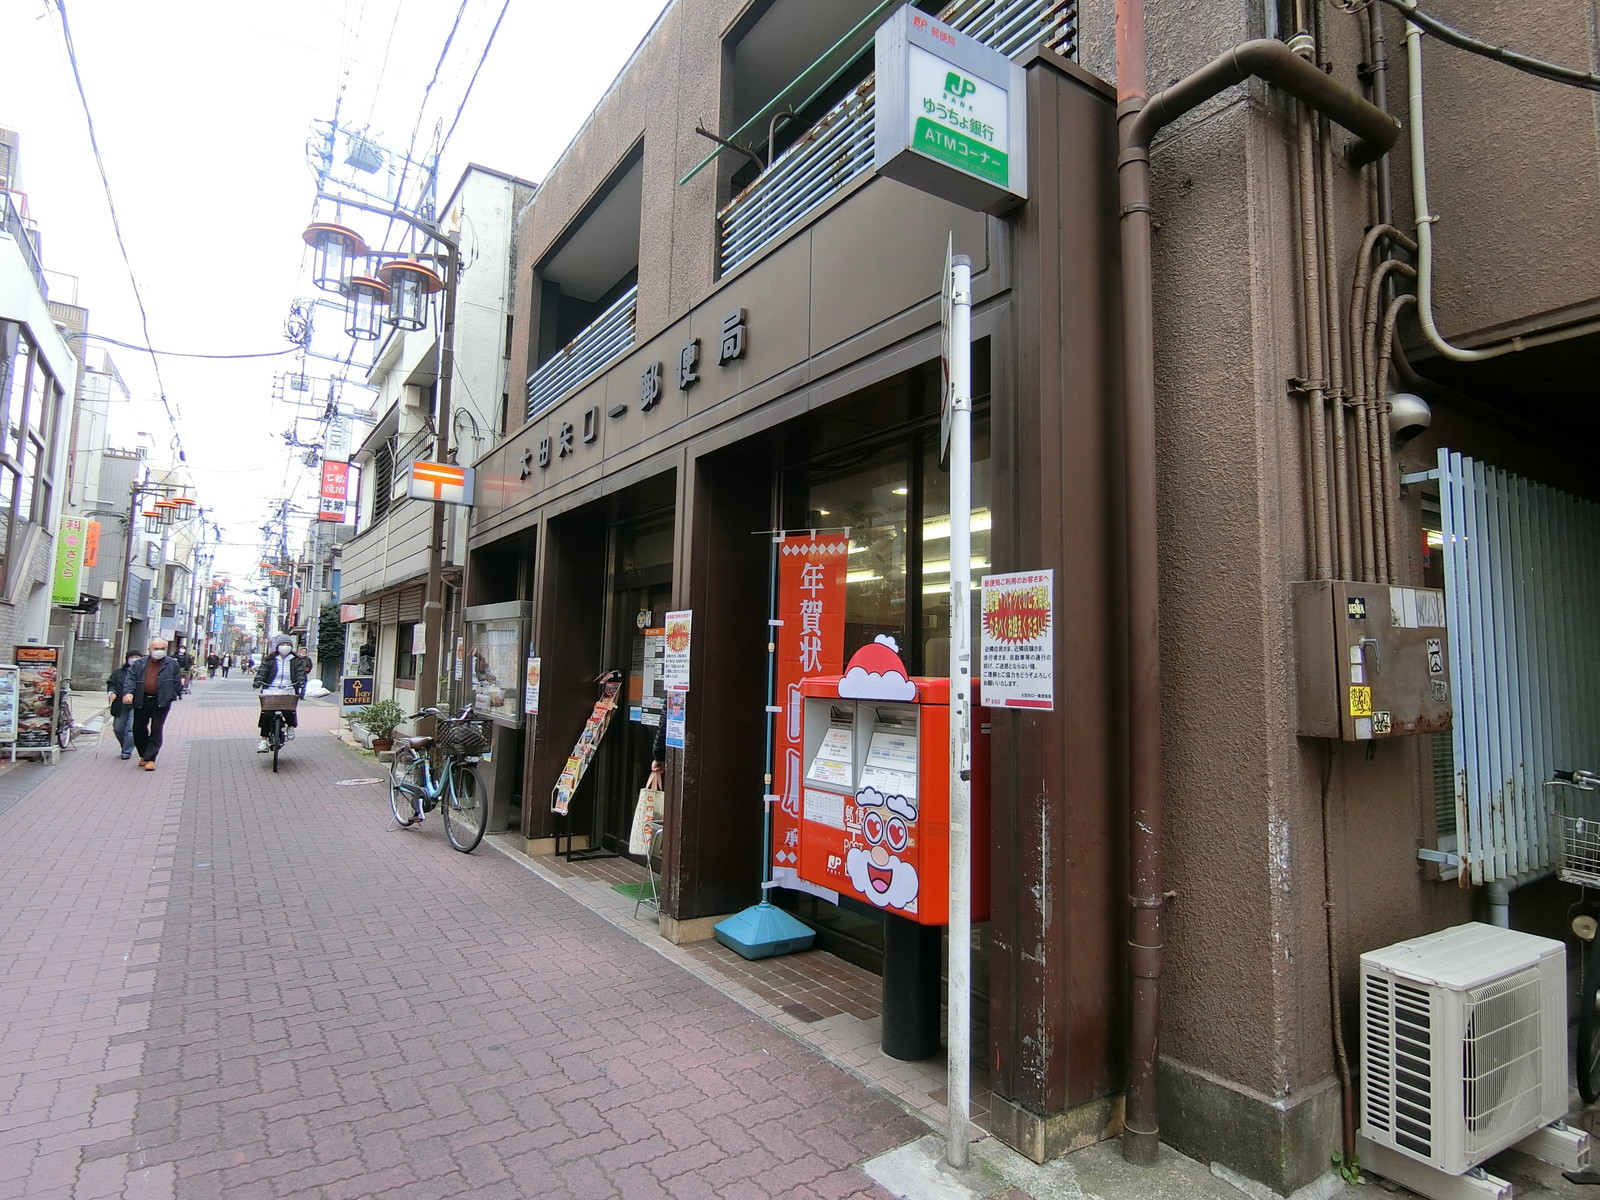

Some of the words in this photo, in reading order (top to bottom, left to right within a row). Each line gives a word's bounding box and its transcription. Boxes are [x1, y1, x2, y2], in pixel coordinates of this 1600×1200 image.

[930, 26, 956, 48] 郵便局
[942, 92, 974, 112] BANK
[923, 97, 994, 142] ゆうちょ銀行
[925, 127, 1001, 166] ATMコーナー
[519, 306, 746, 481] 大田矢口一郵便局
[63, 550, 76, 578] さくら
[984, 575, 1050, 587] 郵便局ご利用のお客さまへ
[799, 562, 825, 674] 年賀状
[845, 804, 865, 826] 郵便
